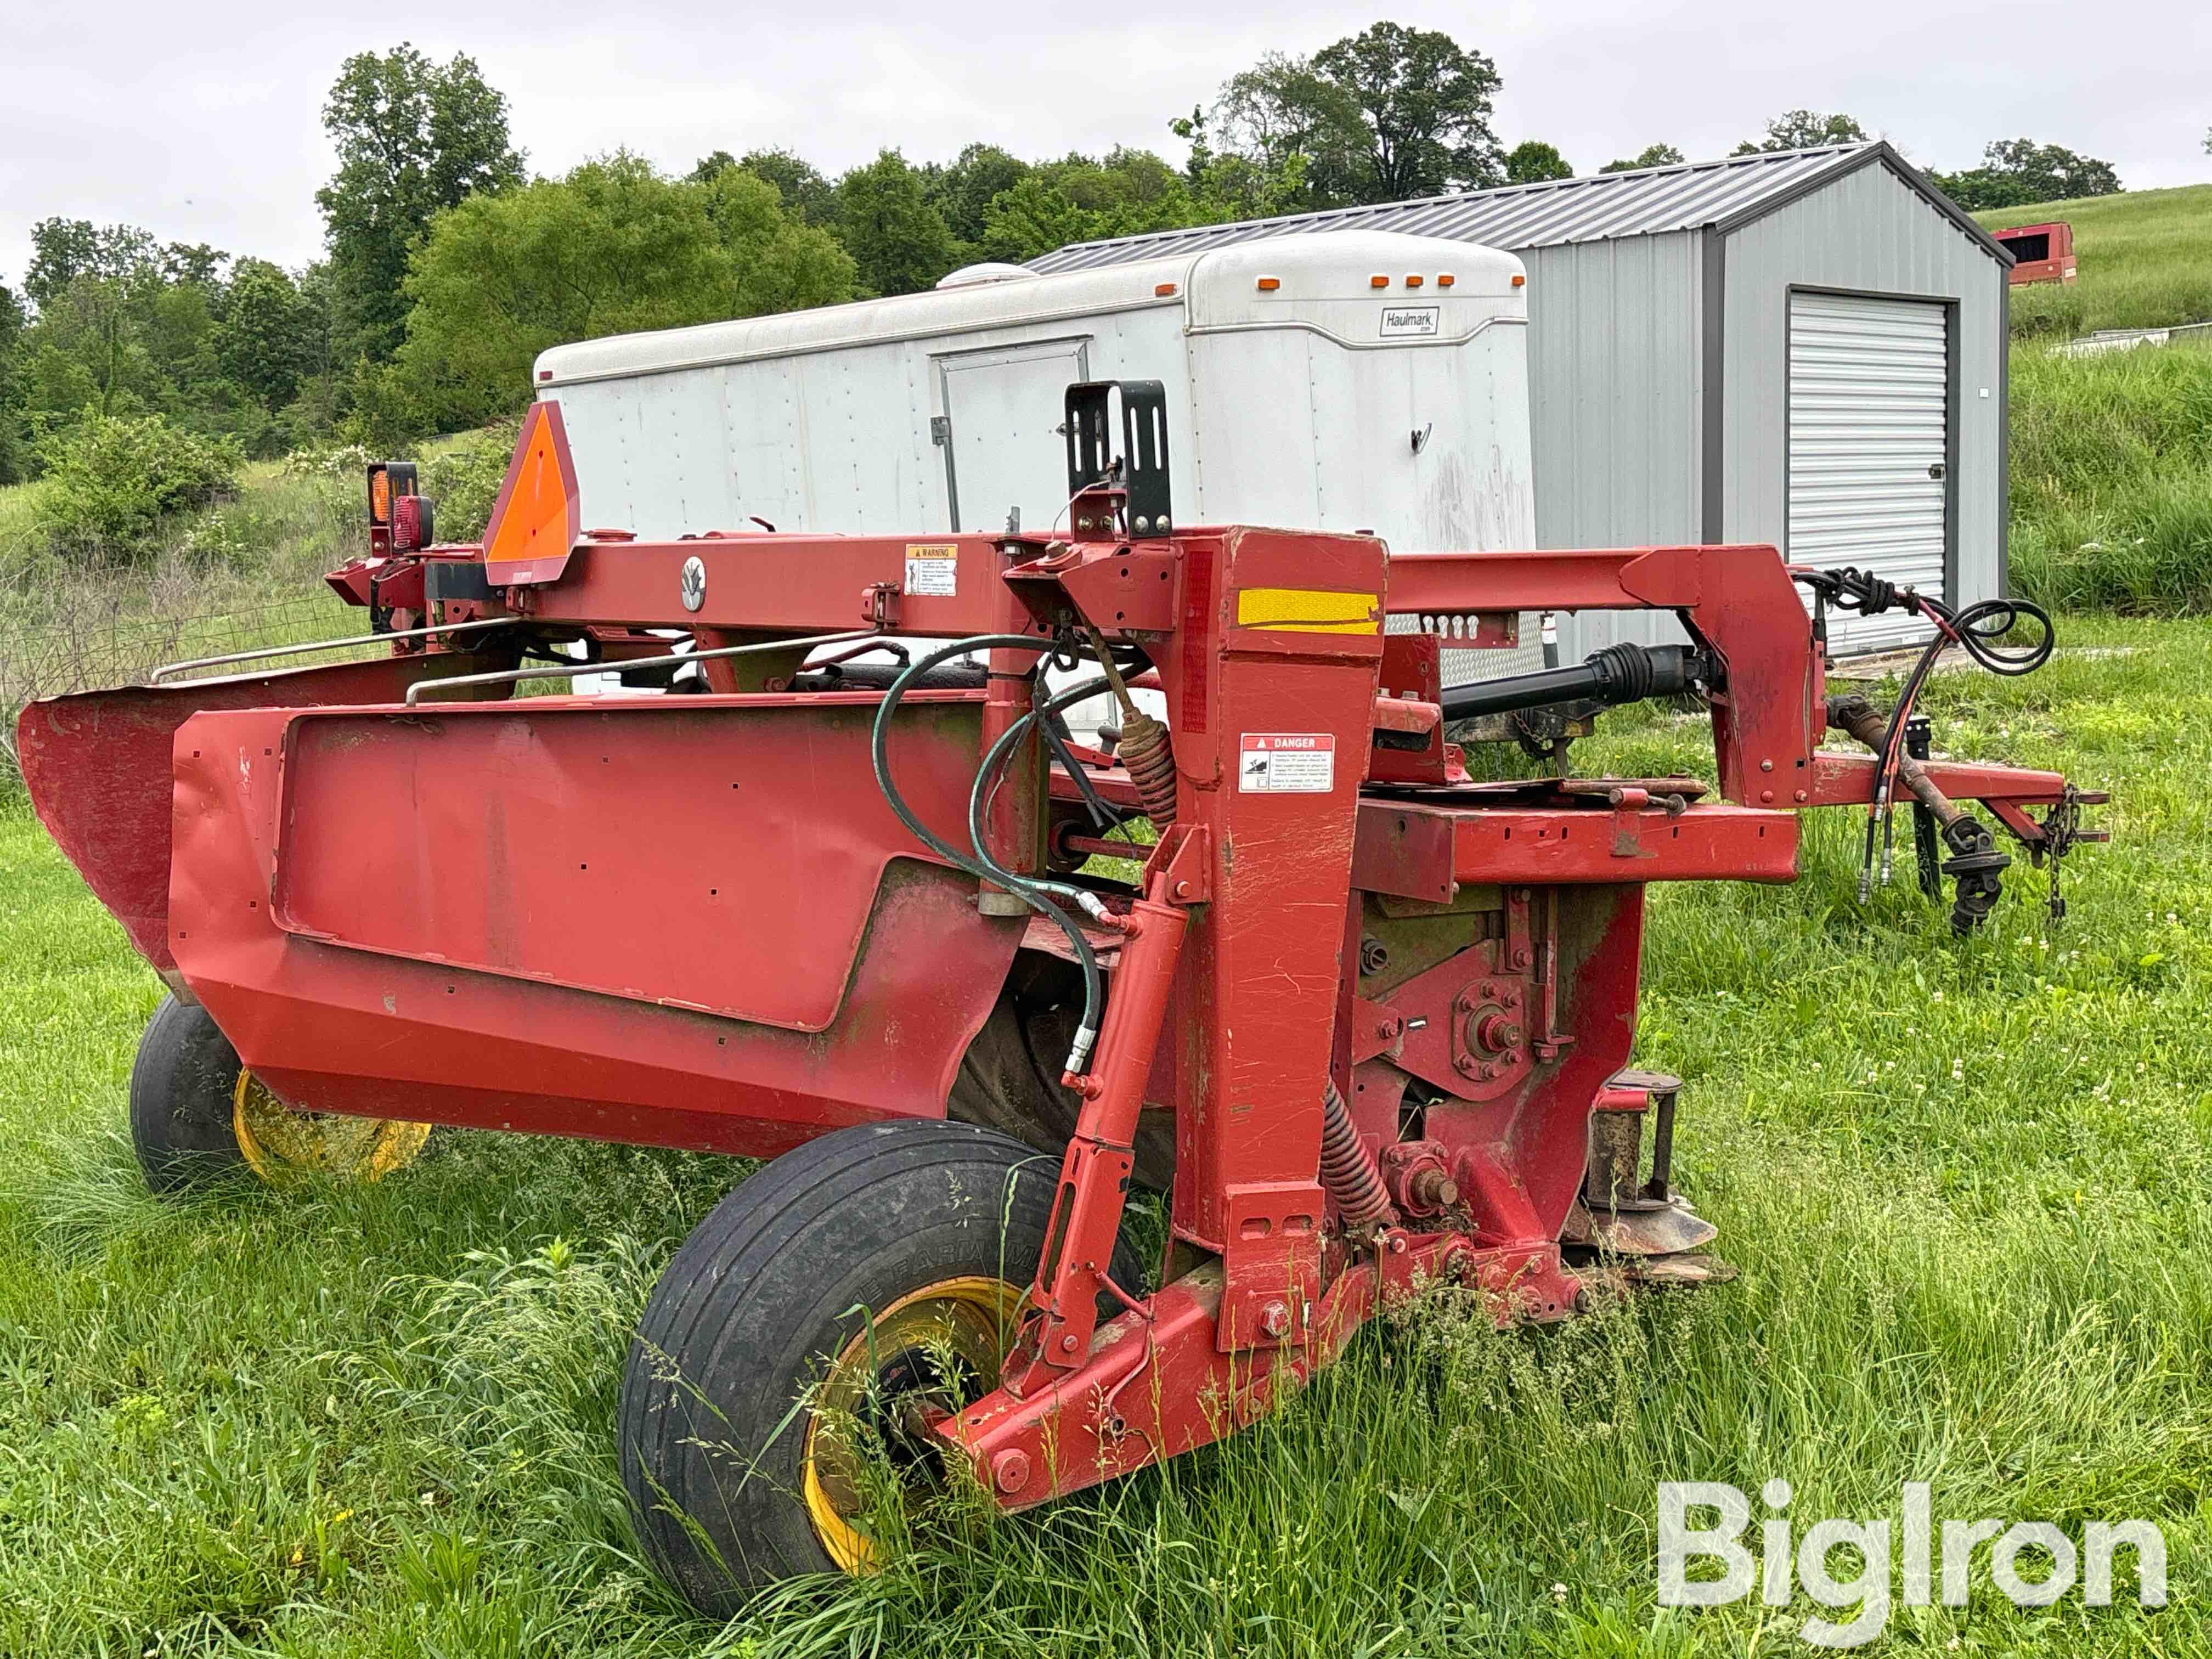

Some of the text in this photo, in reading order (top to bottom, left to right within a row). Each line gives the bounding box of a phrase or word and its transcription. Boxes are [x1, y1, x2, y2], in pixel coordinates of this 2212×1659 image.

[1386, 311, 1431, 326] Haulmark
[922, 549, 949, 557] WARNING
[1274, 738, 1316, 748] DANGER
